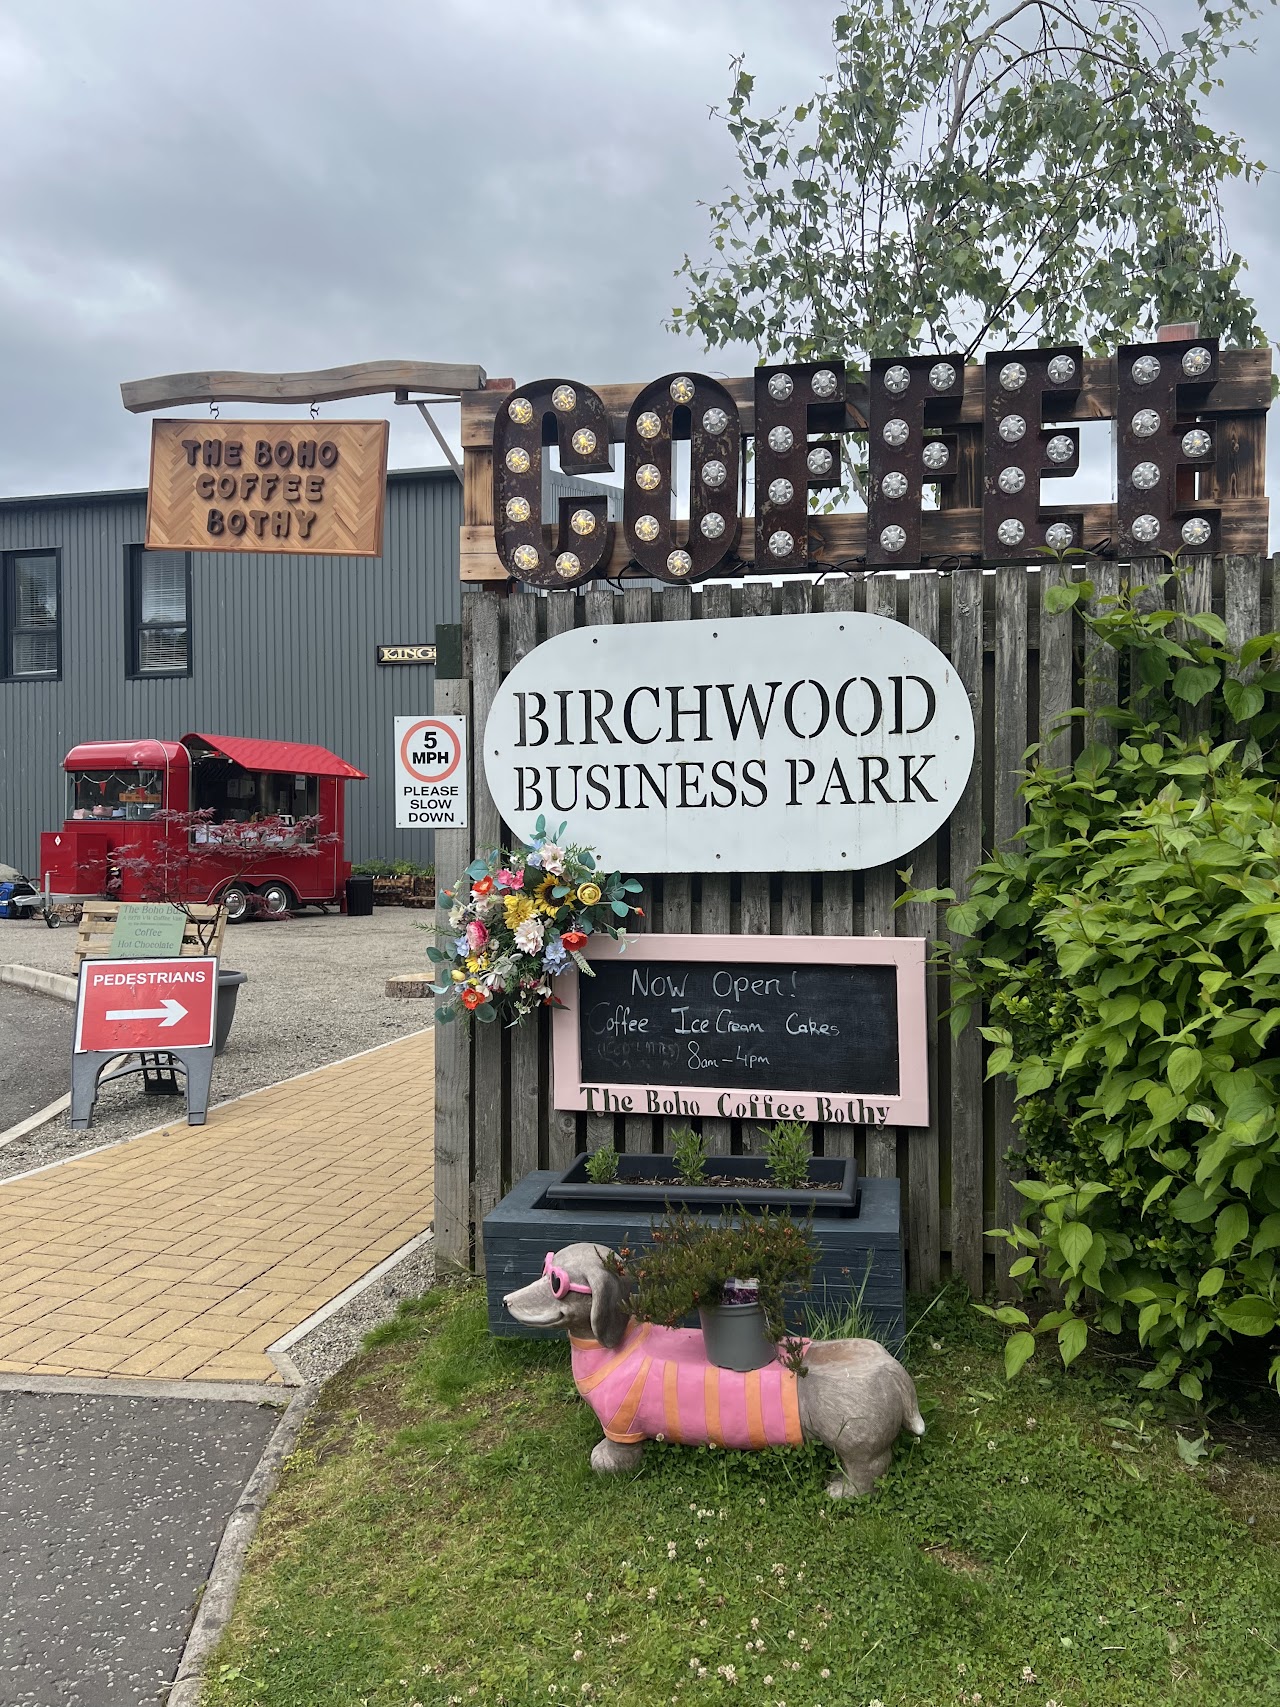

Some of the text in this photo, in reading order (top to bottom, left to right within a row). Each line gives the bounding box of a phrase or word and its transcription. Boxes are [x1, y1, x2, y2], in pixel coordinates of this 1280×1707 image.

[181, 439, 339, 468] THE BOHO
[494, 343, 1221, 587] COFFEE
[196, 472, 325, 502] COFFEE
[207, 508, 316, 538] BOTHY
[381, 646, 436, 661] KING
[512, 675, 937, 747] BIRCHWOOD
[423, 731, 438, 749] 5
[412, 751, 449, 765] MPH
[403, 786, 459, 796] PLEASE
[513, 754, 939, 812] BUSINESS PARK
[410, 799, 452, 809] SLOW
[408, 812, 455, 823] DOWN
[124, 905, 140, 914] The
[142, 905, 164, 914] Boho
[134, 928, 163, 937] Coffee
[117, 940, 174, 949] Hot Chocolate
[93, 971, 206, 987] PEDESTRIANS
[588, 1002, 841, 1037] Coffee Ice Cream Cakes
[579, 1086, 890, 1125] The Boho Coffee Bothy
